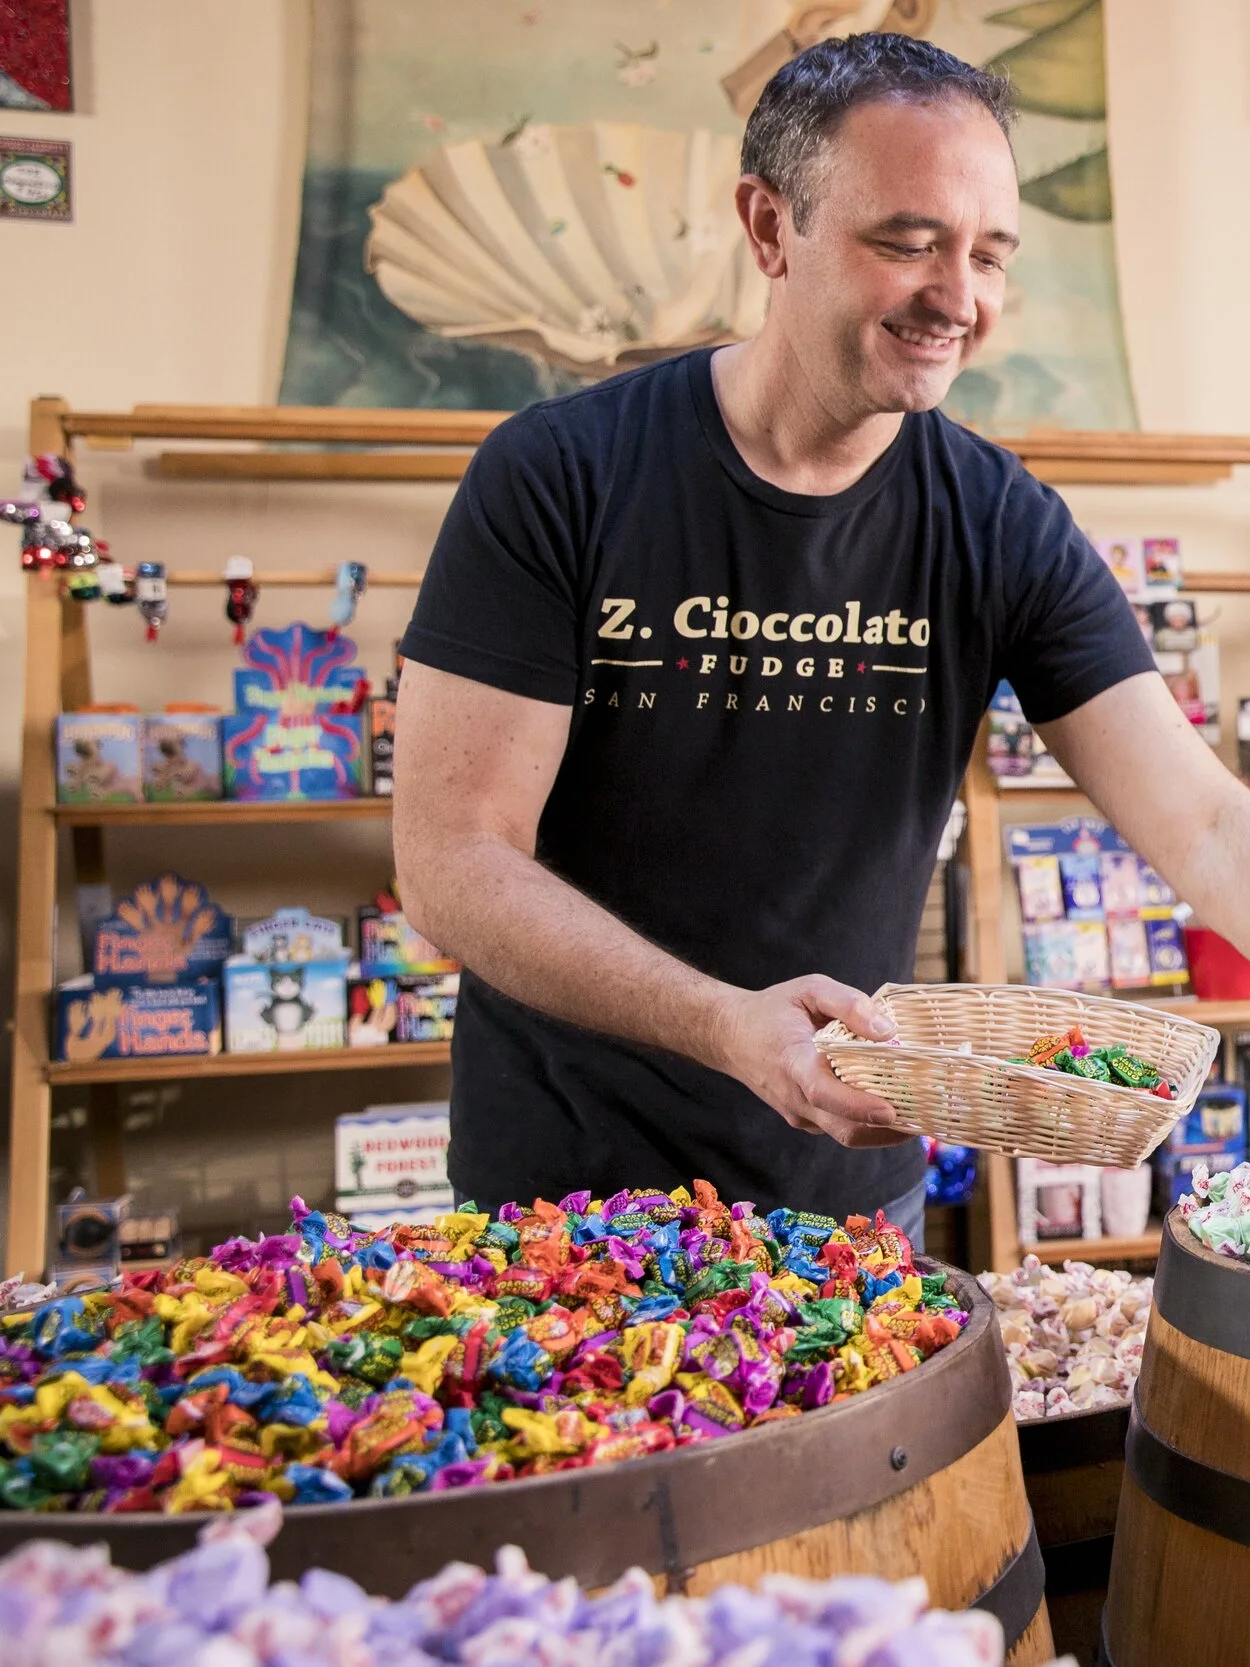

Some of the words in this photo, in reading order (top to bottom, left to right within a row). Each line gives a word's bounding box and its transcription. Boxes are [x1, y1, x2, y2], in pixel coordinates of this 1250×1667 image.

[597, 598, 653, 640] Z.
[673, 595, 931, 647] Cioccolato
[699, 654, 844, 679] FUDGE
[584, 688, 657, 710] SAN
[119, 1023, 209, 1056] Hands
[364, 1135, 449, 1154] REDWOOD
[376, 1156, 438, 1173] FOREST
